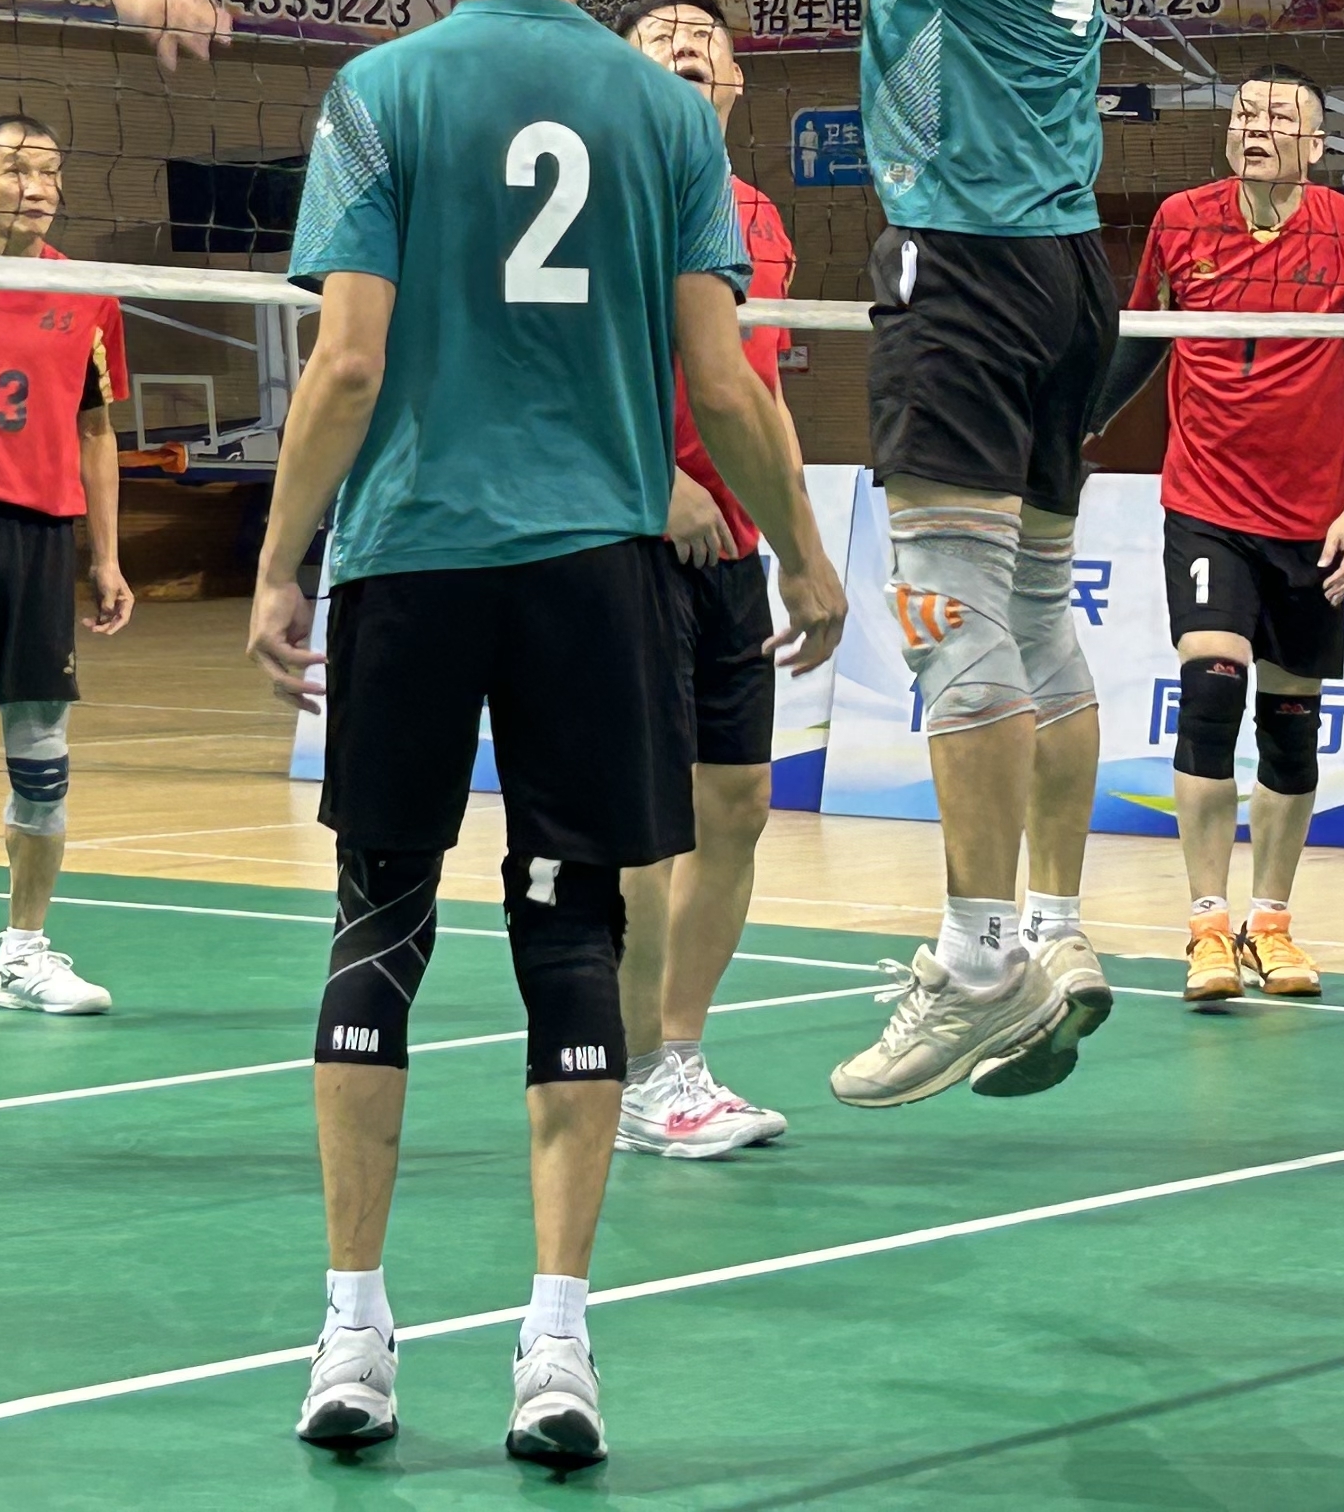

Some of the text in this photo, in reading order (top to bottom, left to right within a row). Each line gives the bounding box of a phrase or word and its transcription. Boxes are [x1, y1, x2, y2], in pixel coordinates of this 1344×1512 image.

[504, 120, 591, 304] 2
[1189, 557, 1211, 605] 1
[344, 1024, 380, 1054] NBA
[575, 1045, 607, 1072] NBA
